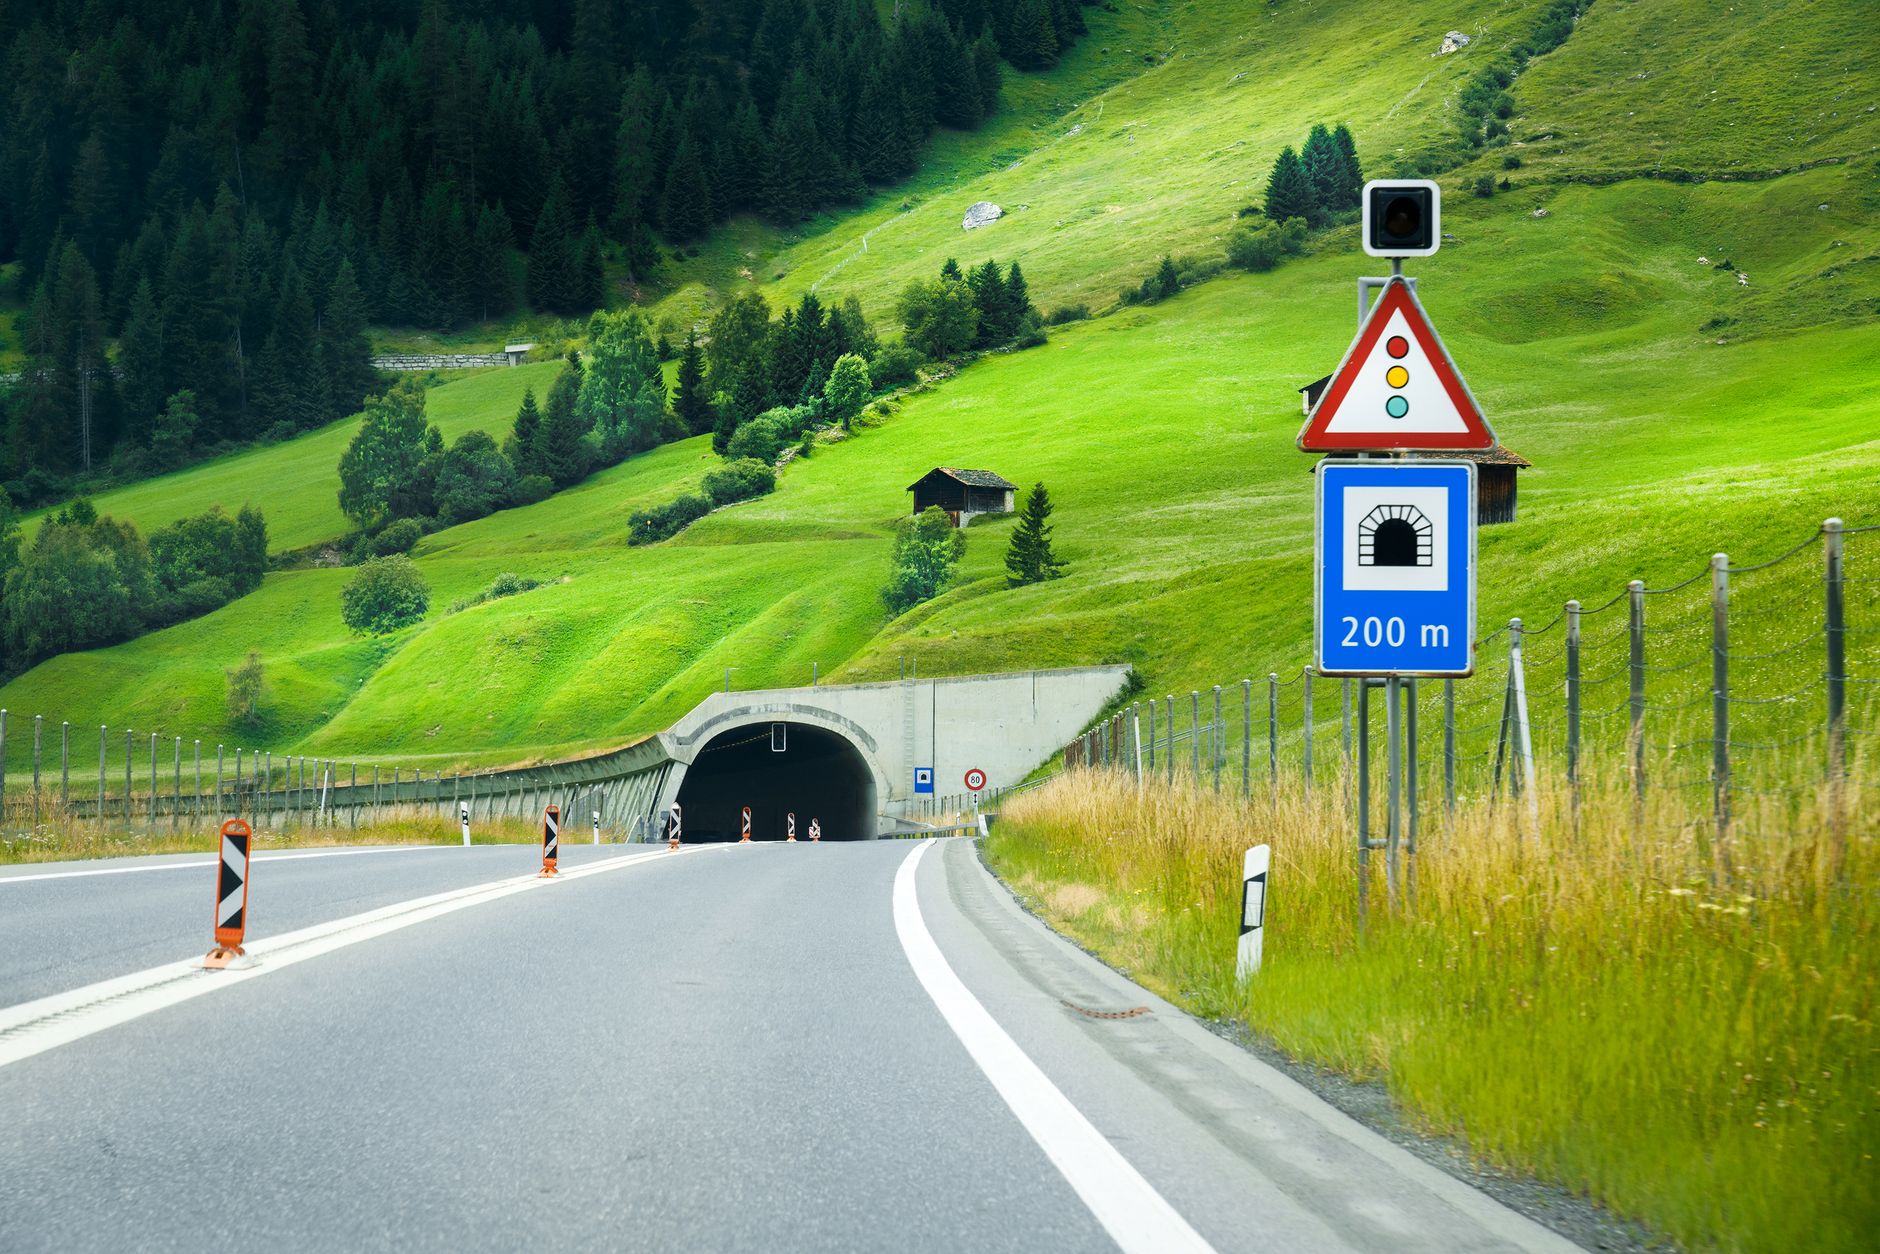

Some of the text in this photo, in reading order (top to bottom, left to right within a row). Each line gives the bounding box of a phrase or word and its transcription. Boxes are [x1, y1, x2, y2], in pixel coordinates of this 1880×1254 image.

[1341, 616, 1449, 647] 200 m
[970, 776, 980, 784] 80
